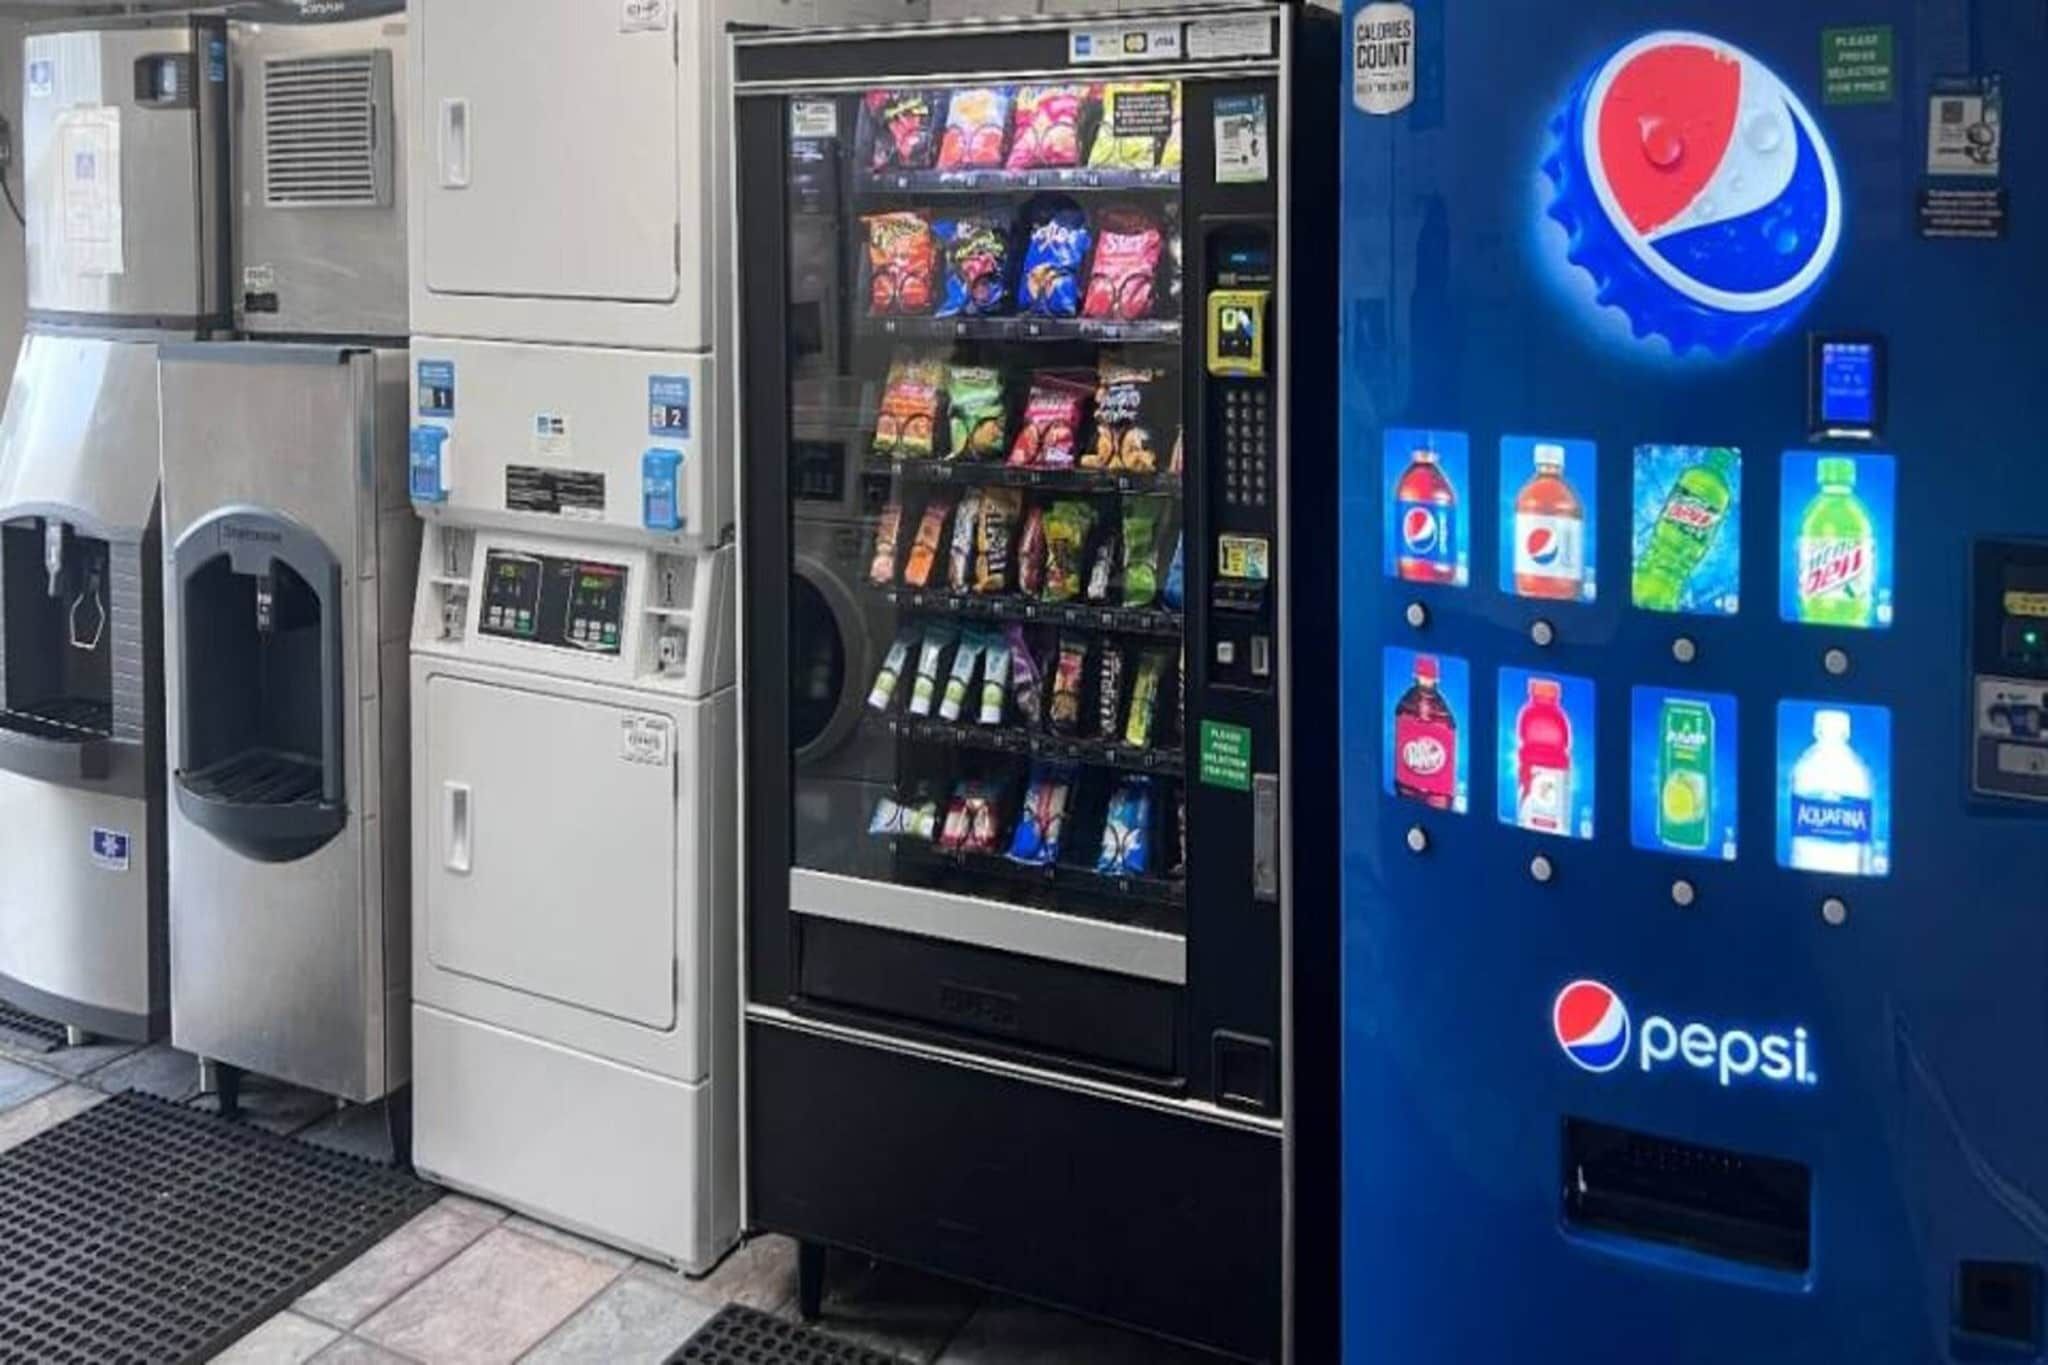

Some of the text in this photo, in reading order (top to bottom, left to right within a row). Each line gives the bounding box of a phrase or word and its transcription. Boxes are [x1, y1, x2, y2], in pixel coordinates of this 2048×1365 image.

[1356, 20, 1411, 41] CALORIES
[1835, 34, 1878, 48] PLEASE
[1356, 41, 1410, 69] COUNT
[670, 408, 682, 427] 2
[1798, 803, 1867, 831] AQUAFINA
